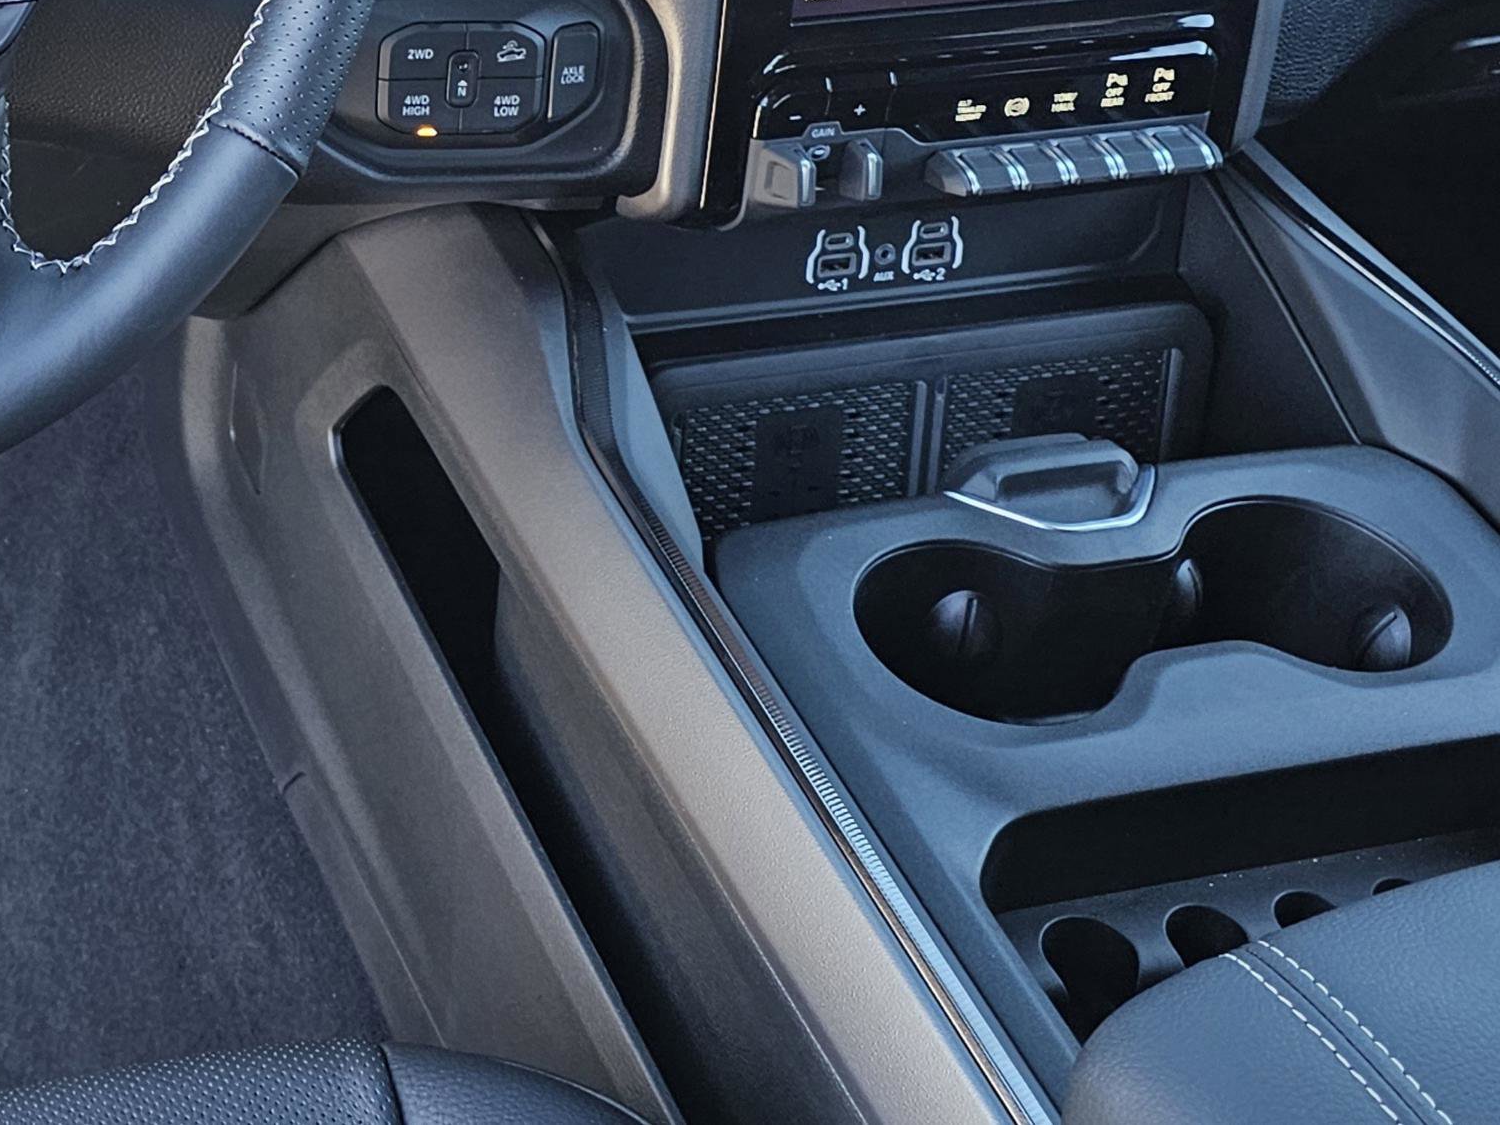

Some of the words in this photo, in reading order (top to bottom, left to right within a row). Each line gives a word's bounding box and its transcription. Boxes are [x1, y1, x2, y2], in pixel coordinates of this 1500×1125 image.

[407, 49, 433, 60] 2WD
[562, 65, 584, 76] AXLE
[561, 75, 584, 85] LOCK
[457, 86, 467, 97] N
[404, 95, 430, 105] 4WD
[494, 95, 520, 105] 4WD
[402, 106, 430, 116] HIGH
[494, 106, 519, 117] LOW
[811, 128, 836, 139] GAIN
[873, 271, 895, 282] AUX
[937, 268, 946, 281] 2
